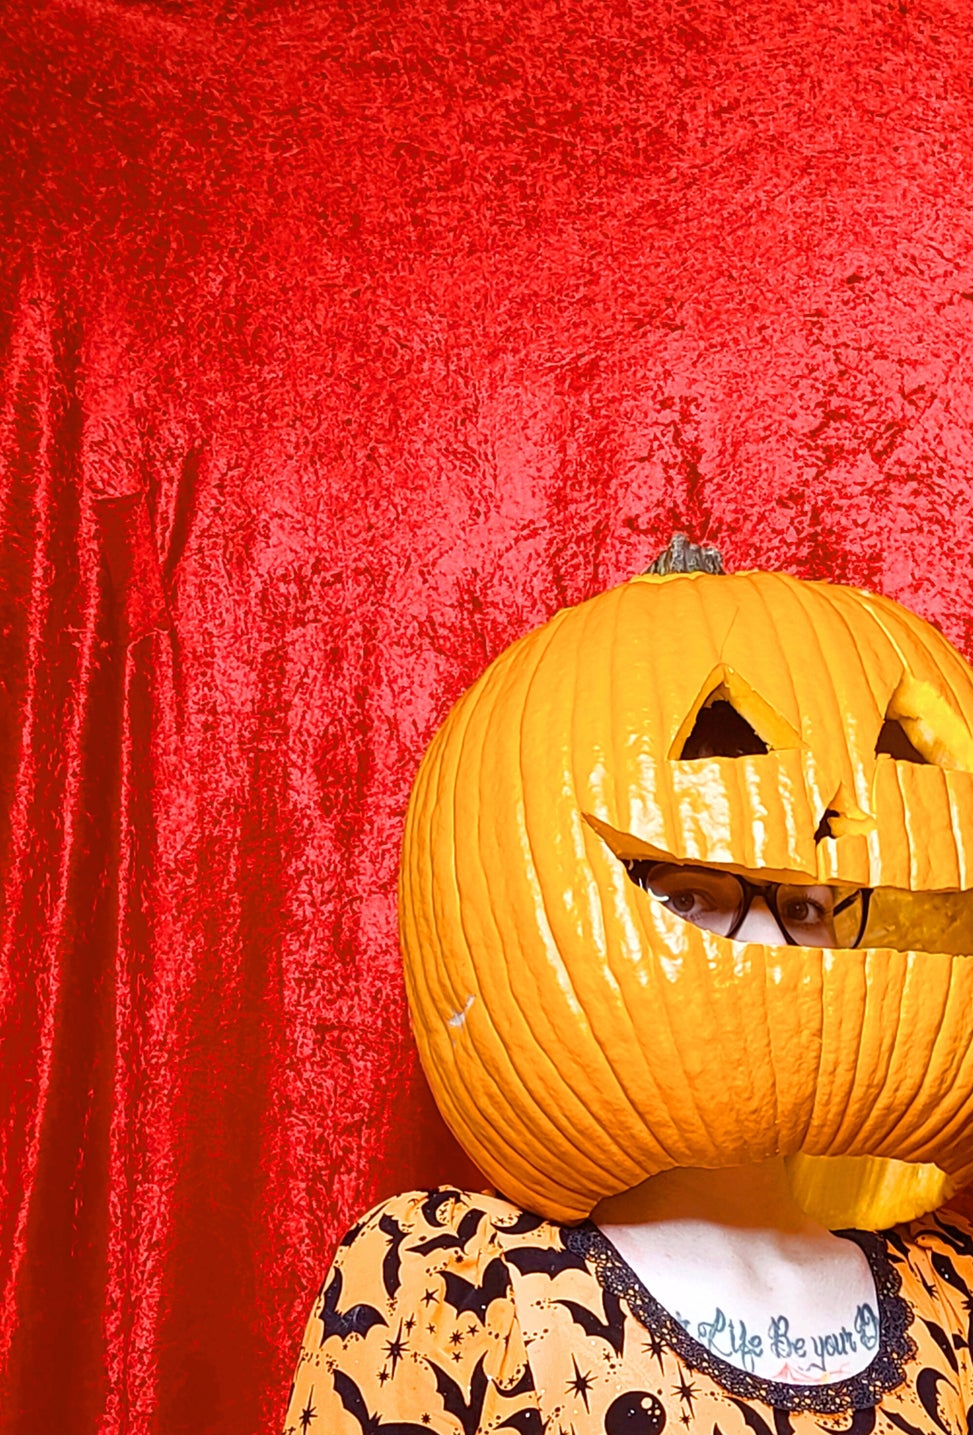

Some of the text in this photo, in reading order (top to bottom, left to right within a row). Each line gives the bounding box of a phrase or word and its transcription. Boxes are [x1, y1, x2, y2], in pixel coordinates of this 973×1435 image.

[697, 1306, 763, 1371] Life
[768, 1315, 806, 1358] Be
[808, 1326, 857, 1371] your
